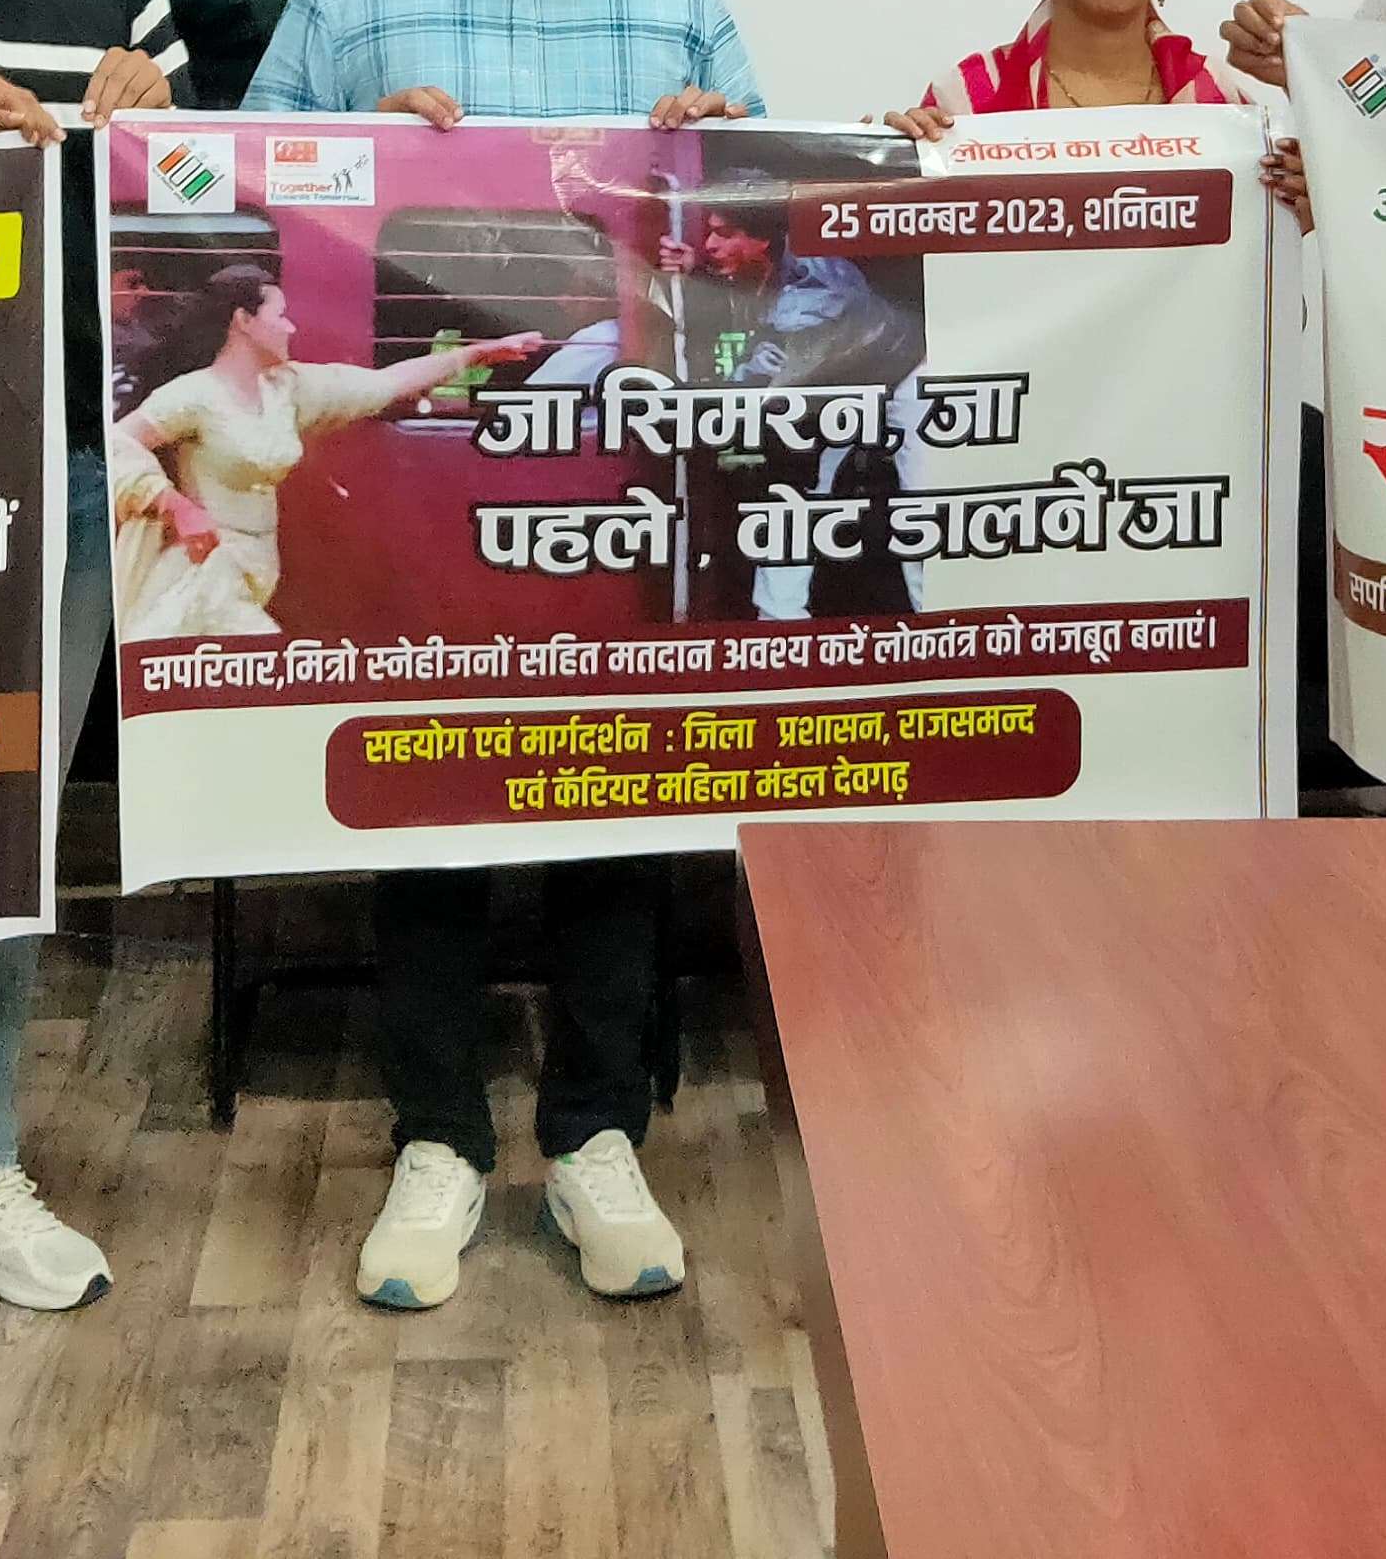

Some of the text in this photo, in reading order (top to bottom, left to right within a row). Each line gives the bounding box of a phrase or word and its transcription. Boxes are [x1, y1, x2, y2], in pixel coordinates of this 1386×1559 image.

[950, 134, 1203, 162] लोकतंत्र का त्यौहार
[820, 186, 1200, 239] 25 नवम्बर 2023, शनिवार
[476, 365, 1024, 456] जा सिमरन, जा
[476, 486, 677, 573] पहले
[737, 483, 872, 561] वोट
[888, 461, 1109, 556] डालनें
[1125, 482, 1223, 544] जा
[363, 634, 516, 681] स्नेहीजनों
[516, 632, 602, 676] सहित
[607, 639, 716, 674] मतदान
[723, 635, 812, 670] अवश्य
[816, 624, 870, 666] करें
[871, 618, 980, 664] लोकतंत्र
[983, 613, 1026, 656] को
[1029, 619, 1124, 665] मजबूत
[362, 718, 468, 763] सहयोग
[472, 717, 515, 758] एवं
[519, 713, 651, 757] मार्गदर्शन
[681, 710, 757, 751] जिला
[775, 710, 892, 749] प्रशासन,
[896, 704, 1037, 740] राजसमन्द
[505, 769, 548, 811] एवं
[655, 762, 751, 804] महिला
[754, 761, 828, 799] मंडल
[831, 755, 910, 801] देवगढ़
